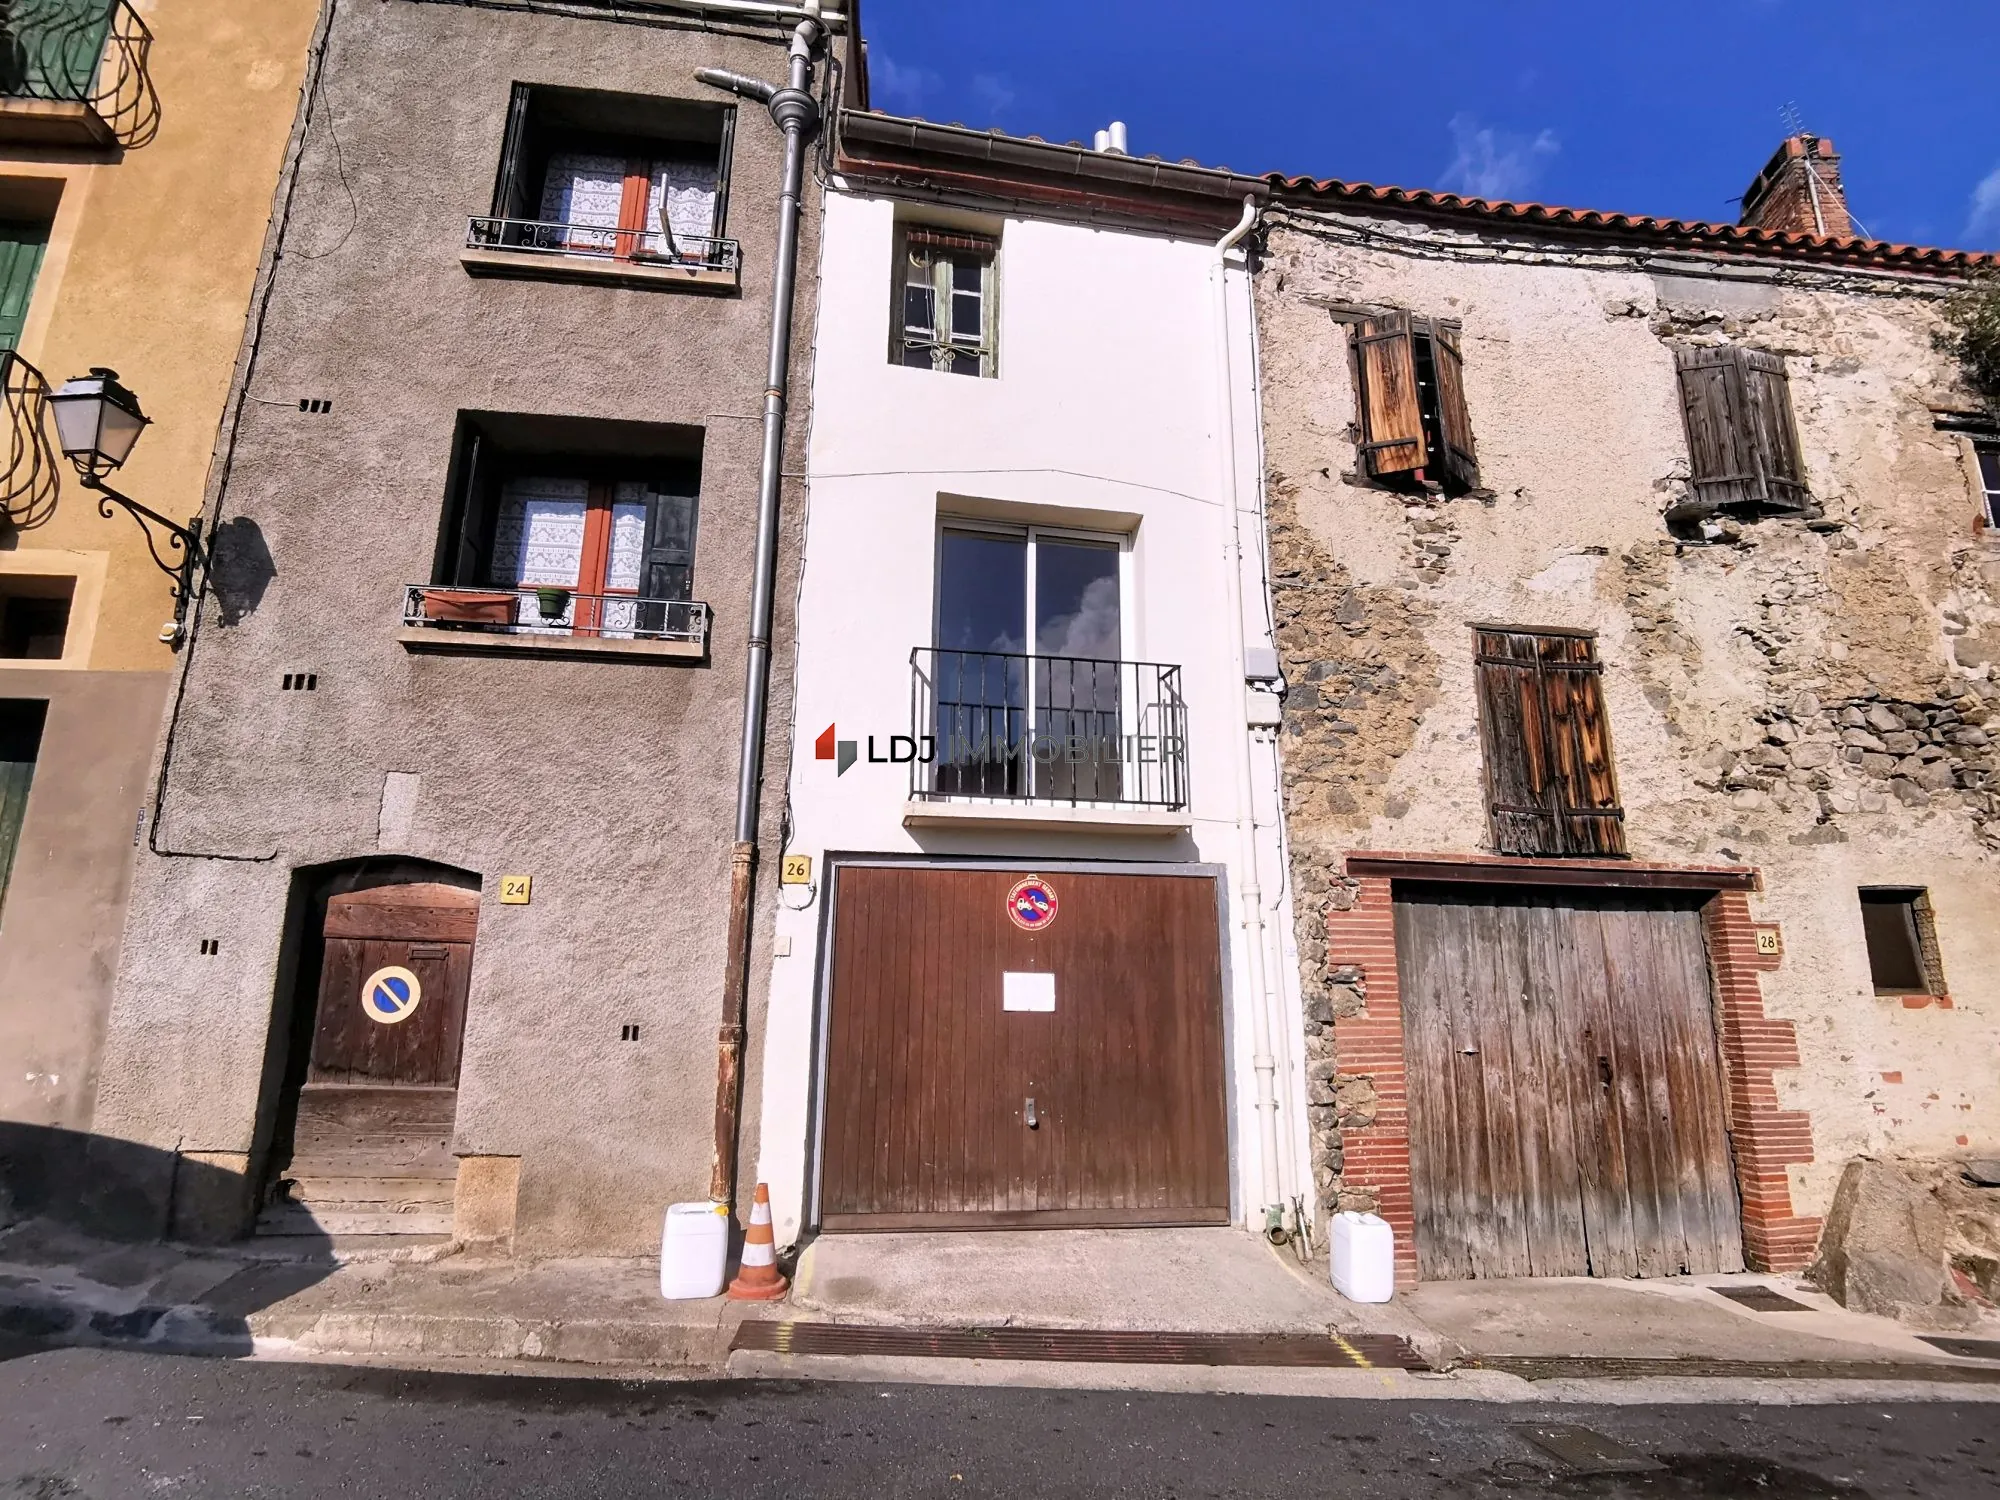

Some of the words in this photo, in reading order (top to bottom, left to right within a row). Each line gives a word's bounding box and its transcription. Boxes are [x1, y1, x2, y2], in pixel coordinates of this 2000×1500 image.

[787, 862, 805, 876] 26
[506, 882, 525, 896] 24
[1760, 935, 1775, 948] 28
